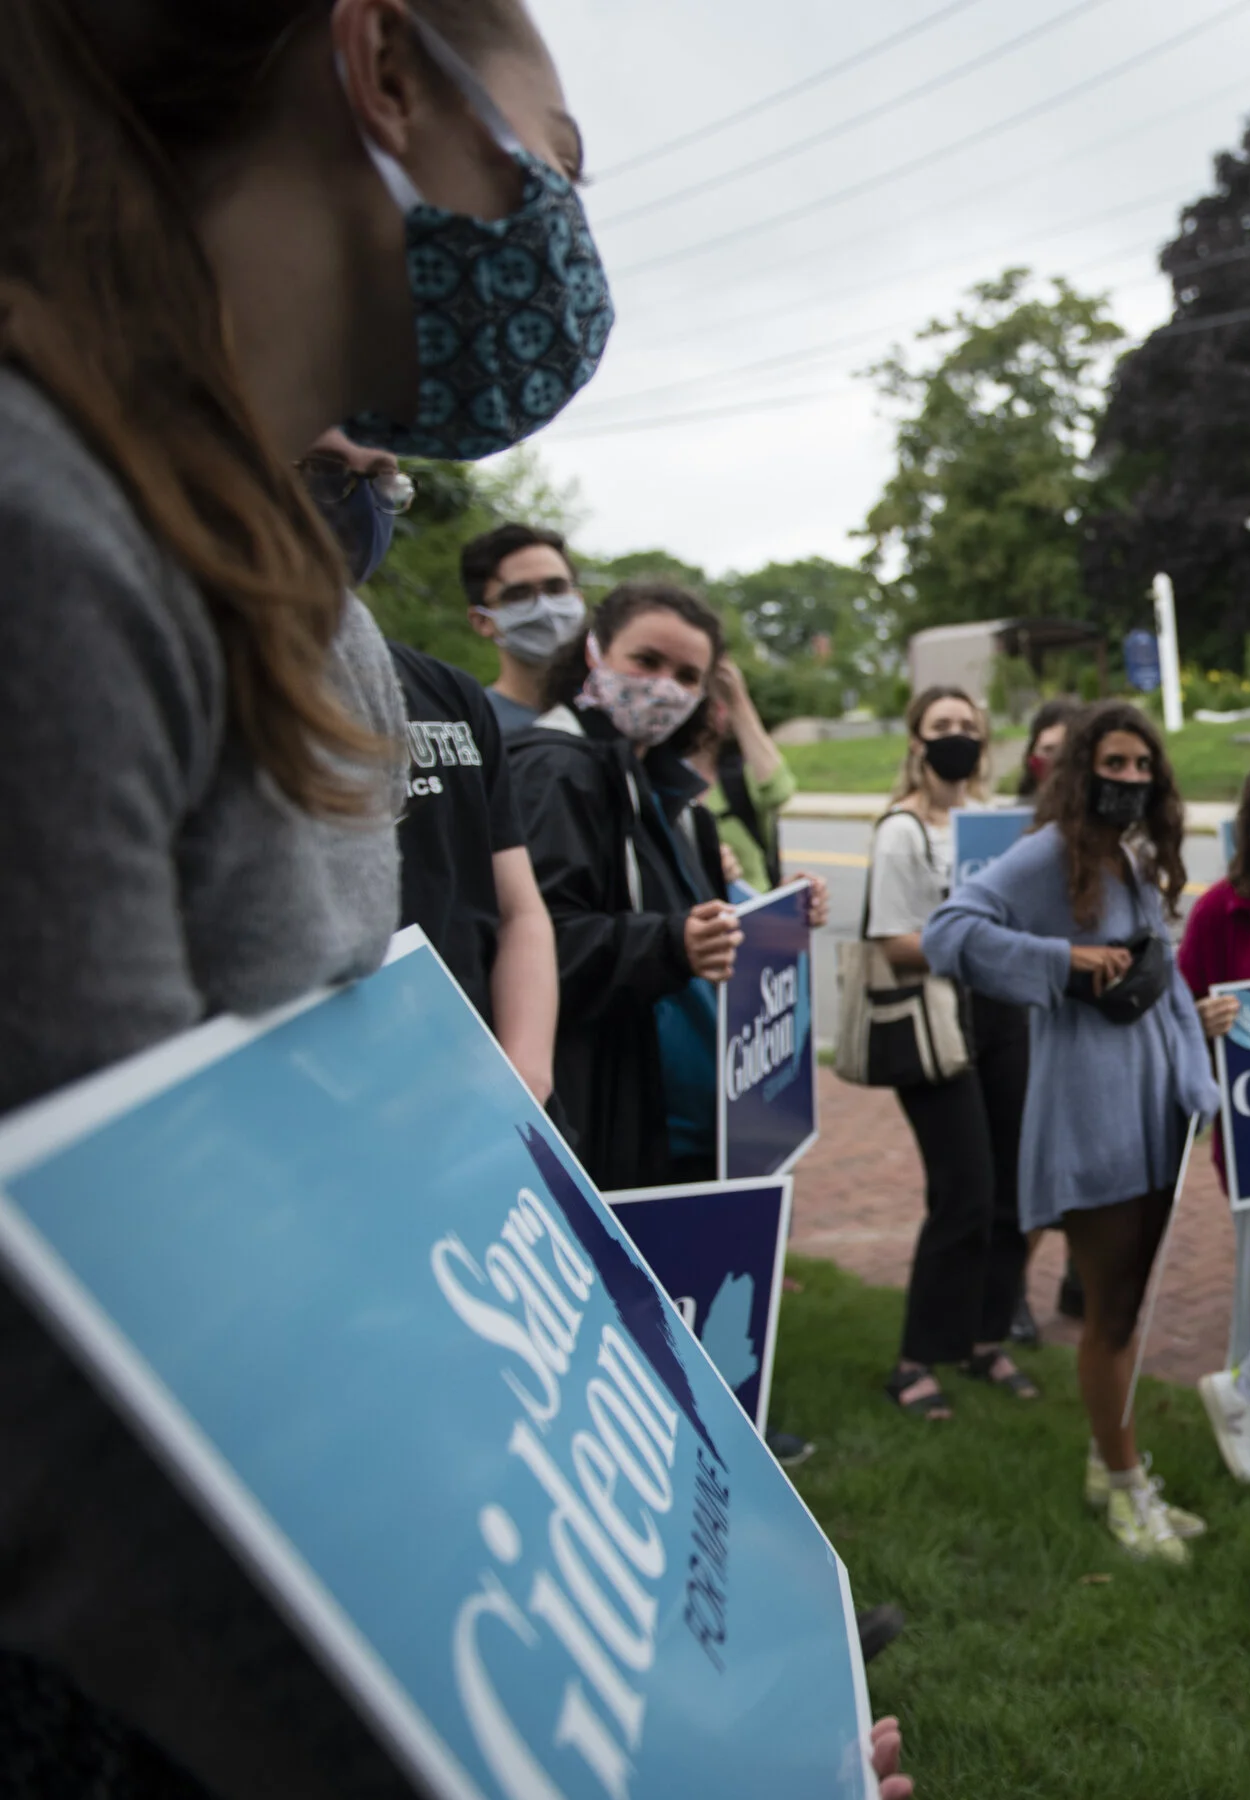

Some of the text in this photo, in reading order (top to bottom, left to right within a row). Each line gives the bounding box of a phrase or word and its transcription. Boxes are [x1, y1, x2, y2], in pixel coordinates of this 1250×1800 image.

[405, 720, 483, 768] UTH
[760, 965, 797, 1024] Sara
[727, 1010, 794, 1102] Gideon
[430, 1187, 594, 1423] Sara
[453, 1324, 682, 1800] Gideon
